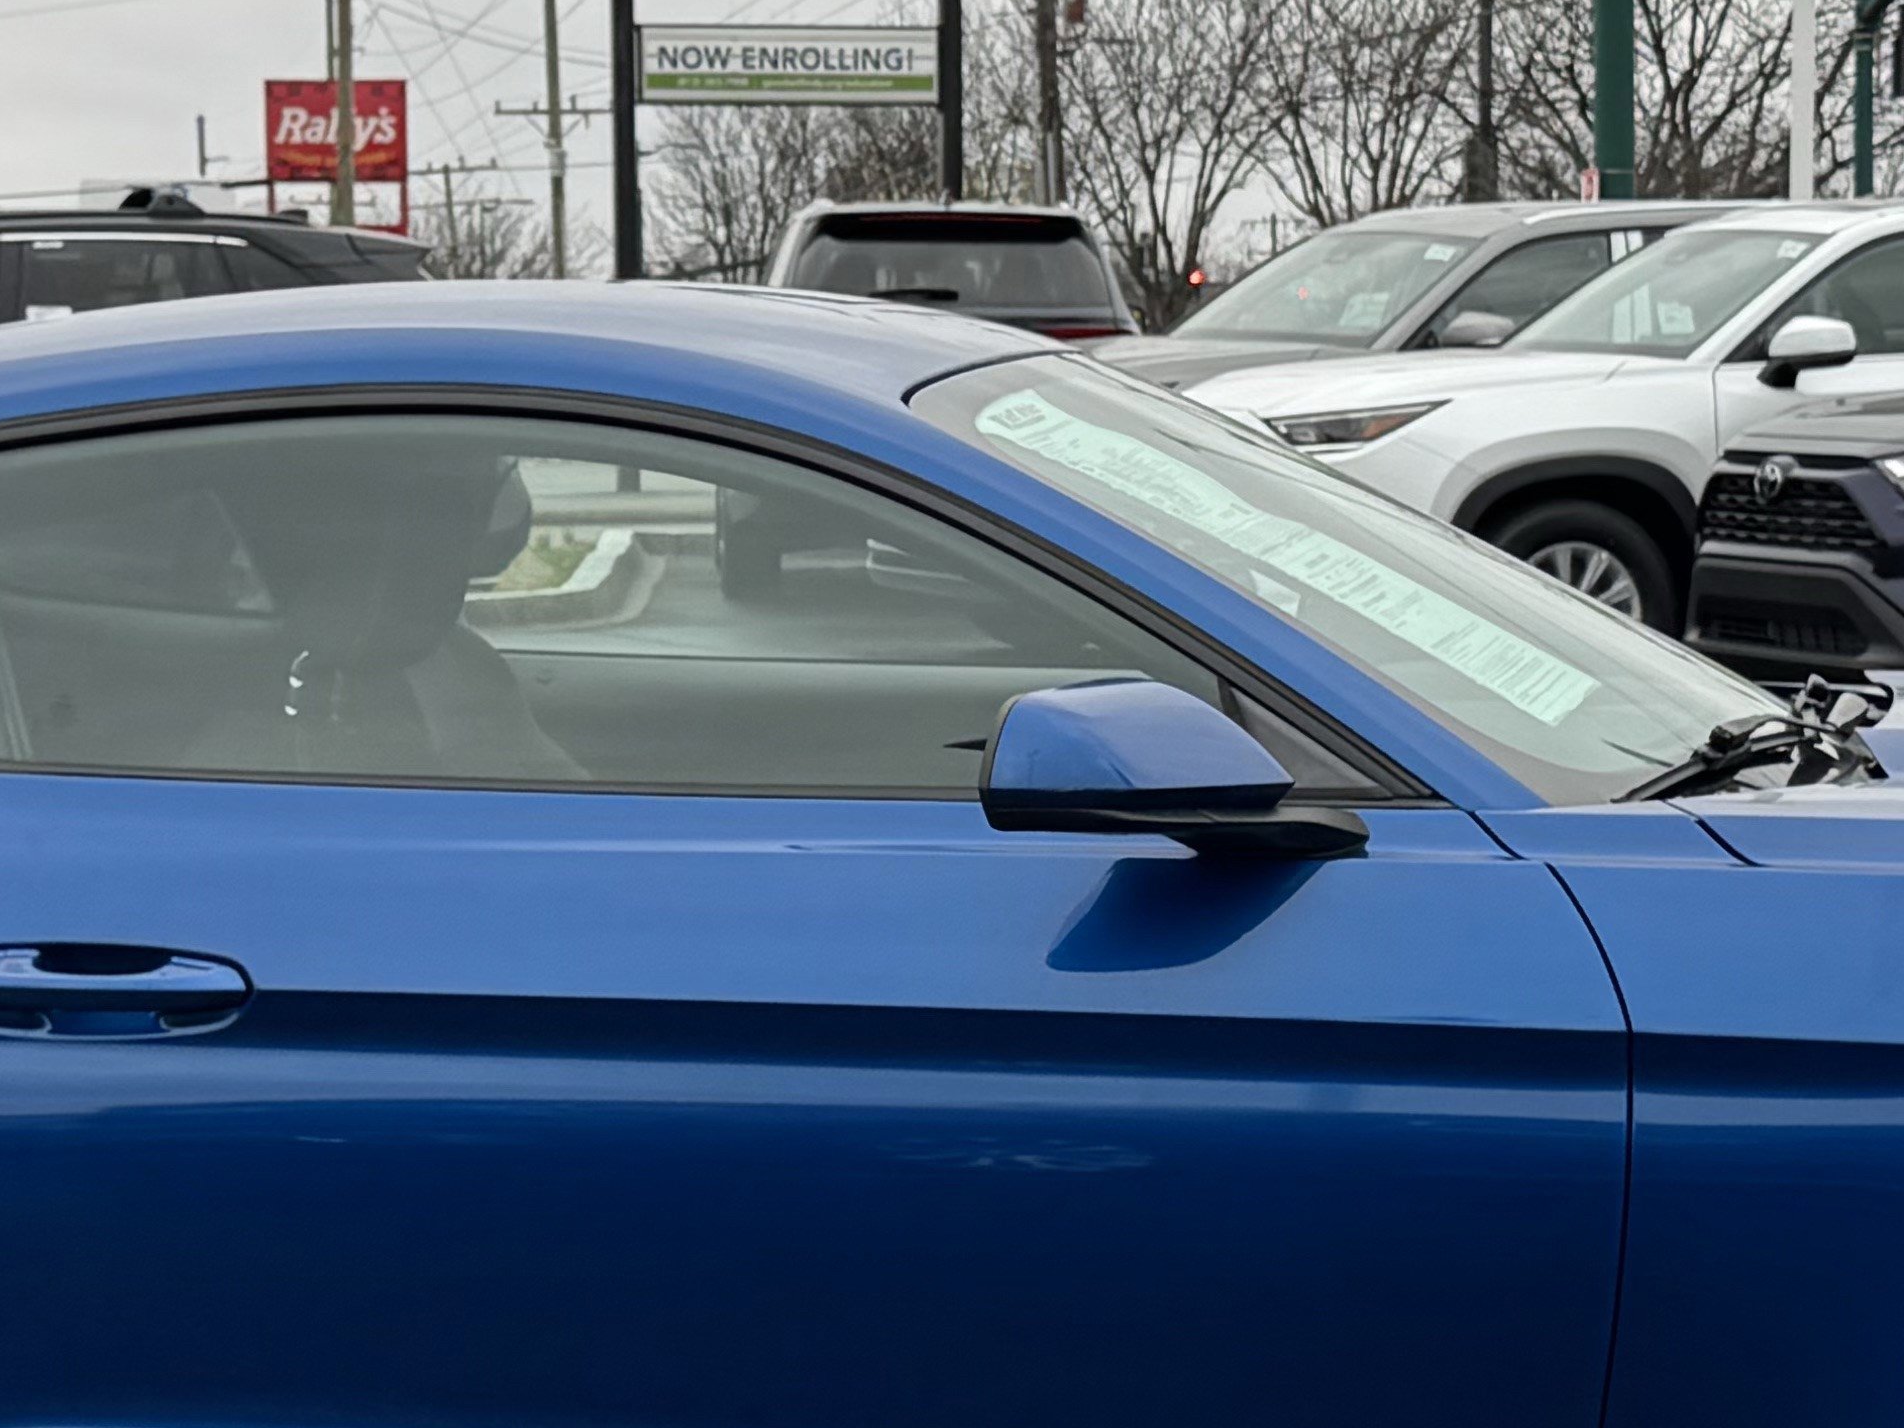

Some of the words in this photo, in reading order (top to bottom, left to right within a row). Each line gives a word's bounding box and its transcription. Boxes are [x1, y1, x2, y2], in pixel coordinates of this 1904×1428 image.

[657, 46, 733, 71] NOW
[741, 47, 915, 73] ENROLLING!
[274, 105, 398, 152] Raly's
